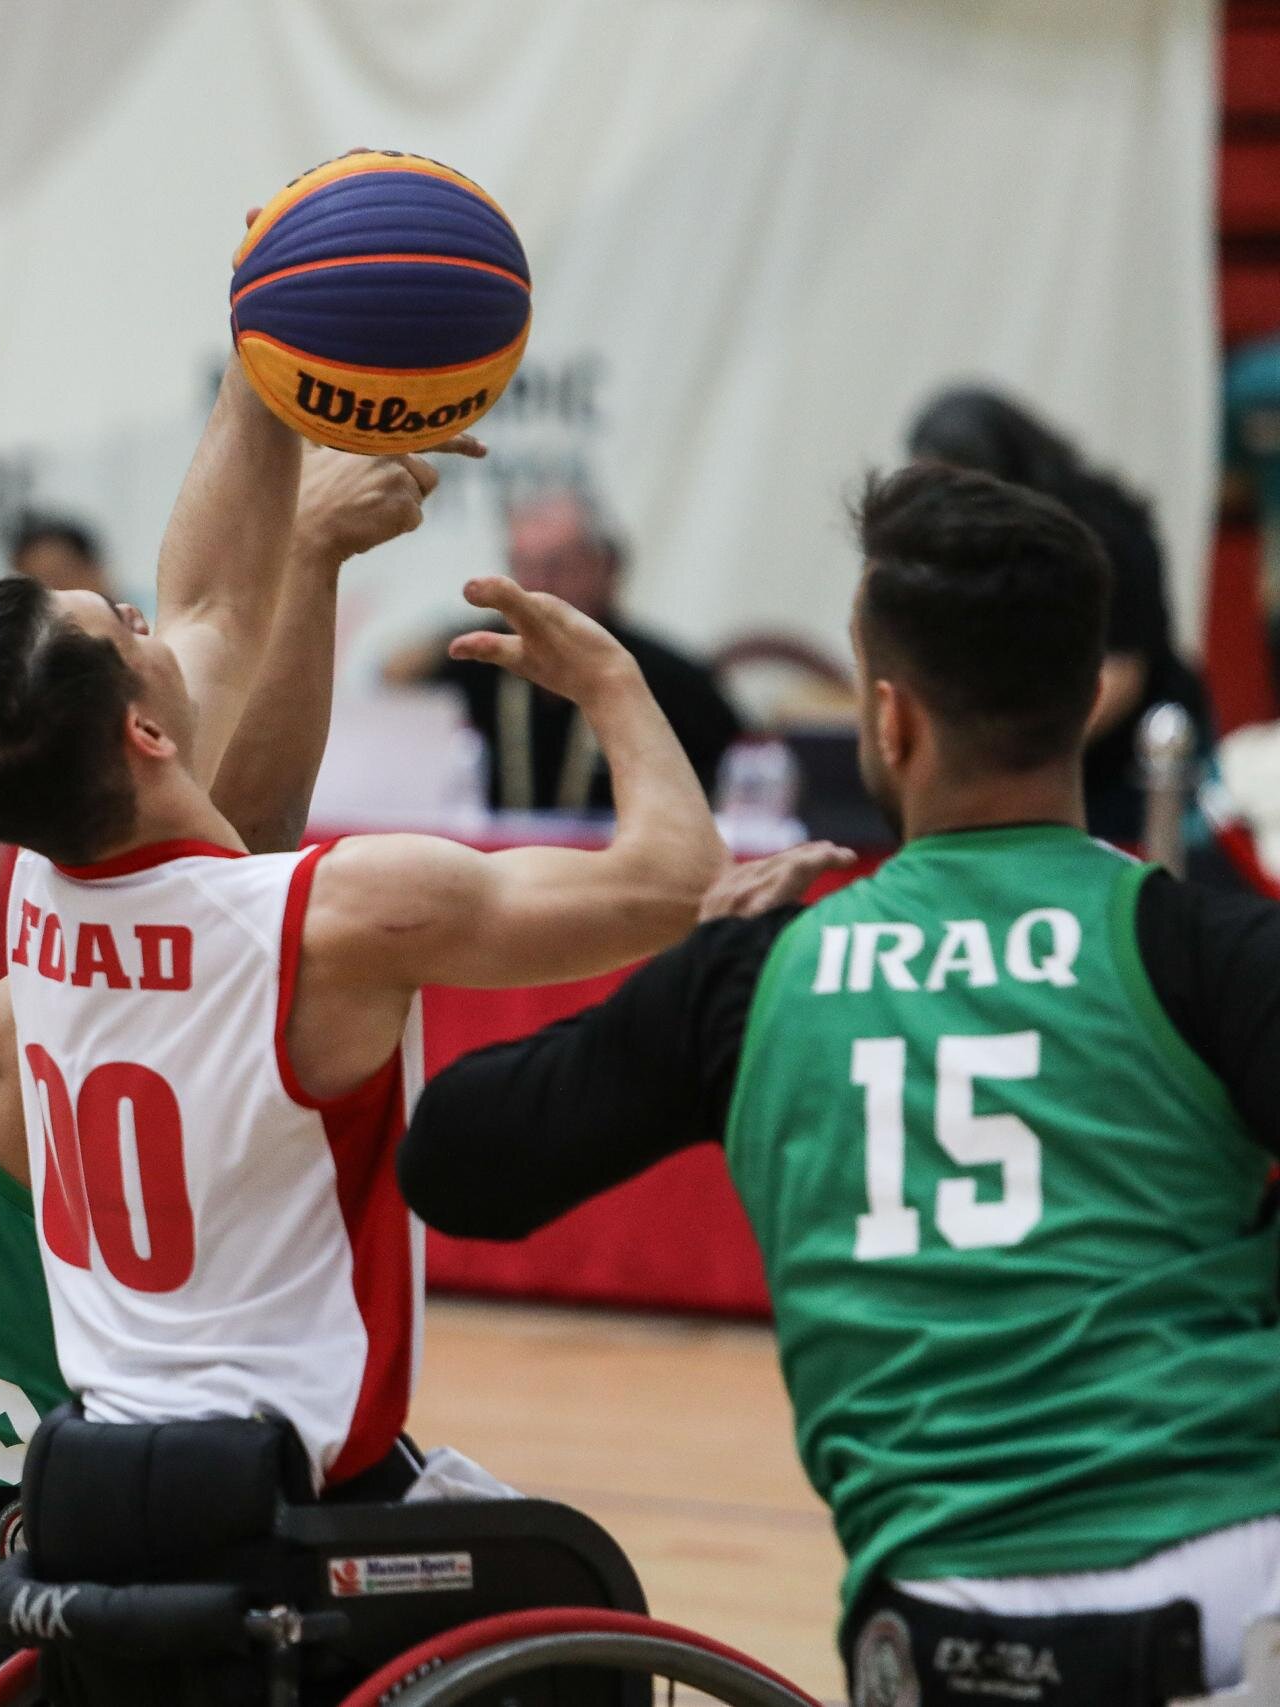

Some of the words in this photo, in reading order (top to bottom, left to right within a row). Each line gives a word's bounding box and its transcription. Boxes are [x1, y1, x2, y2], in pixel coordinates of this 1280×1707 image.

[297, 371, 488, 433] Wilson
[11, 898, 194, 992] FOAD
[811, 907, 1082, 994] IRAQ
[850, 1030, 1043, 1262] 15
